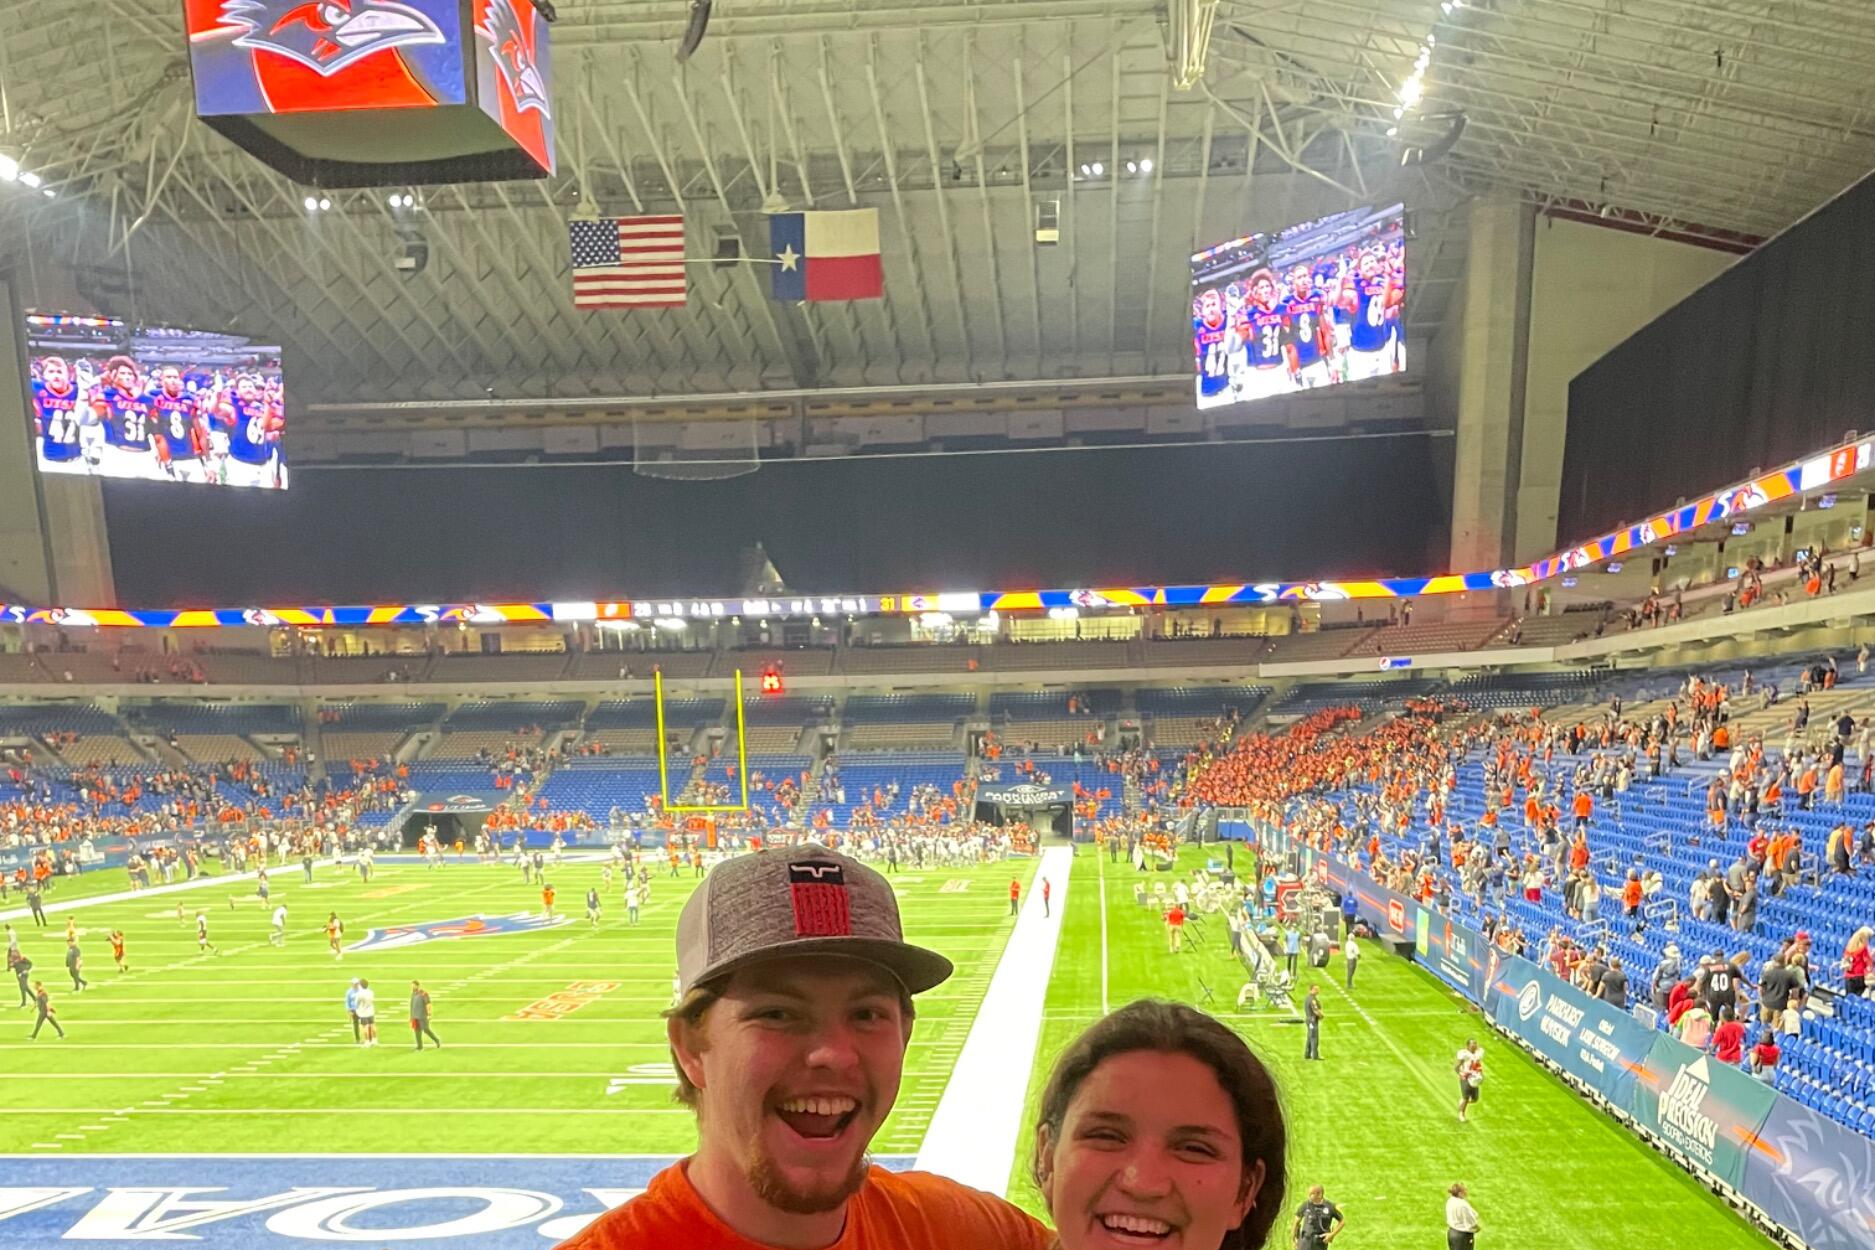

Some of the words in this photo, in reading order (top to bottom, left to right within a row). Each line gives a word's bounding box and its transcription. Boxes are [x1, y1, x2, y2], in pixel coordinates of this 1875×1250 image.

[1262, 325, 1280, 357] 31
[48, 409, 77, 444] 42
[124, 410, 147, 442] 31
[169, 410, 185, 440] 8
[879, 597, 896, 612] 31
[1711, 973, 1729, 991] 40
[1667, 1063, 1709, 1112] IDEAL
